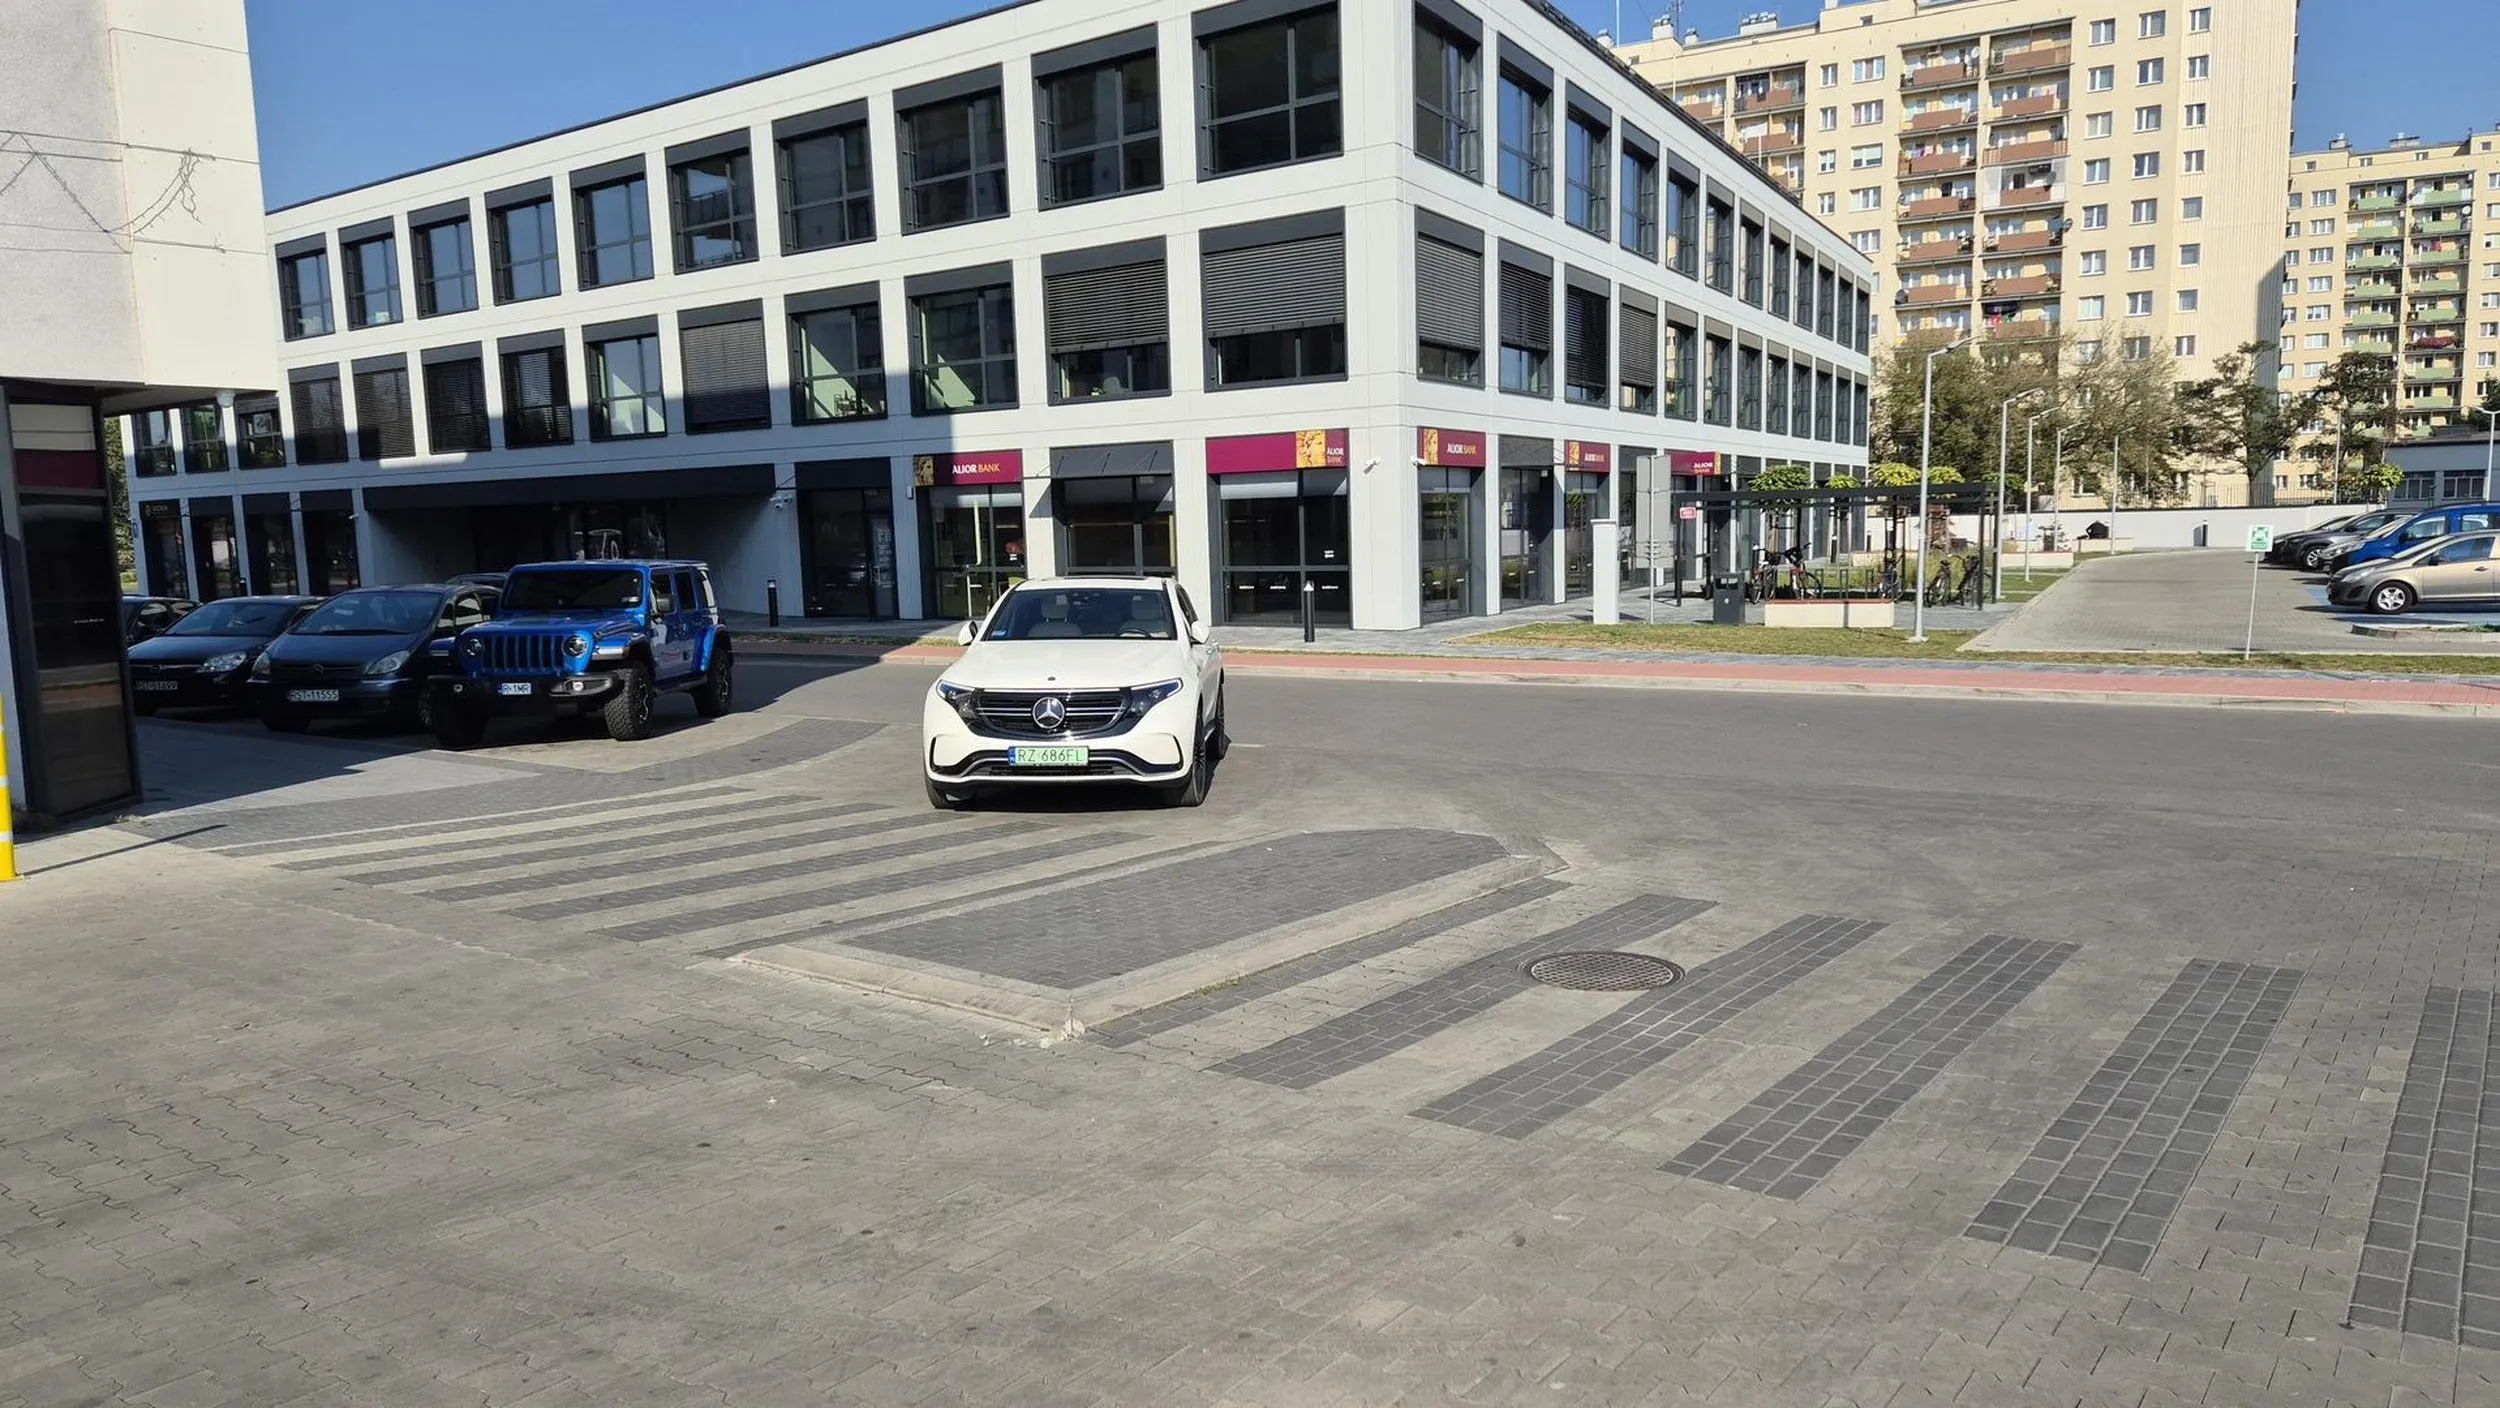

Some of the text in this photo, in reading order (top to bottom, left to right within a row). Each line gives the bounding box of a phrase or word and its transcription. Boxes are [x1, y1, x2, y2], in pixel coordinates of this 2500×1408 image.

[1327, 447, 1345, 456] ALIOR
[952, 463, 1000, 474] ALIOR BANK
[1018, 749, 1083, 762] RZ 686FL
